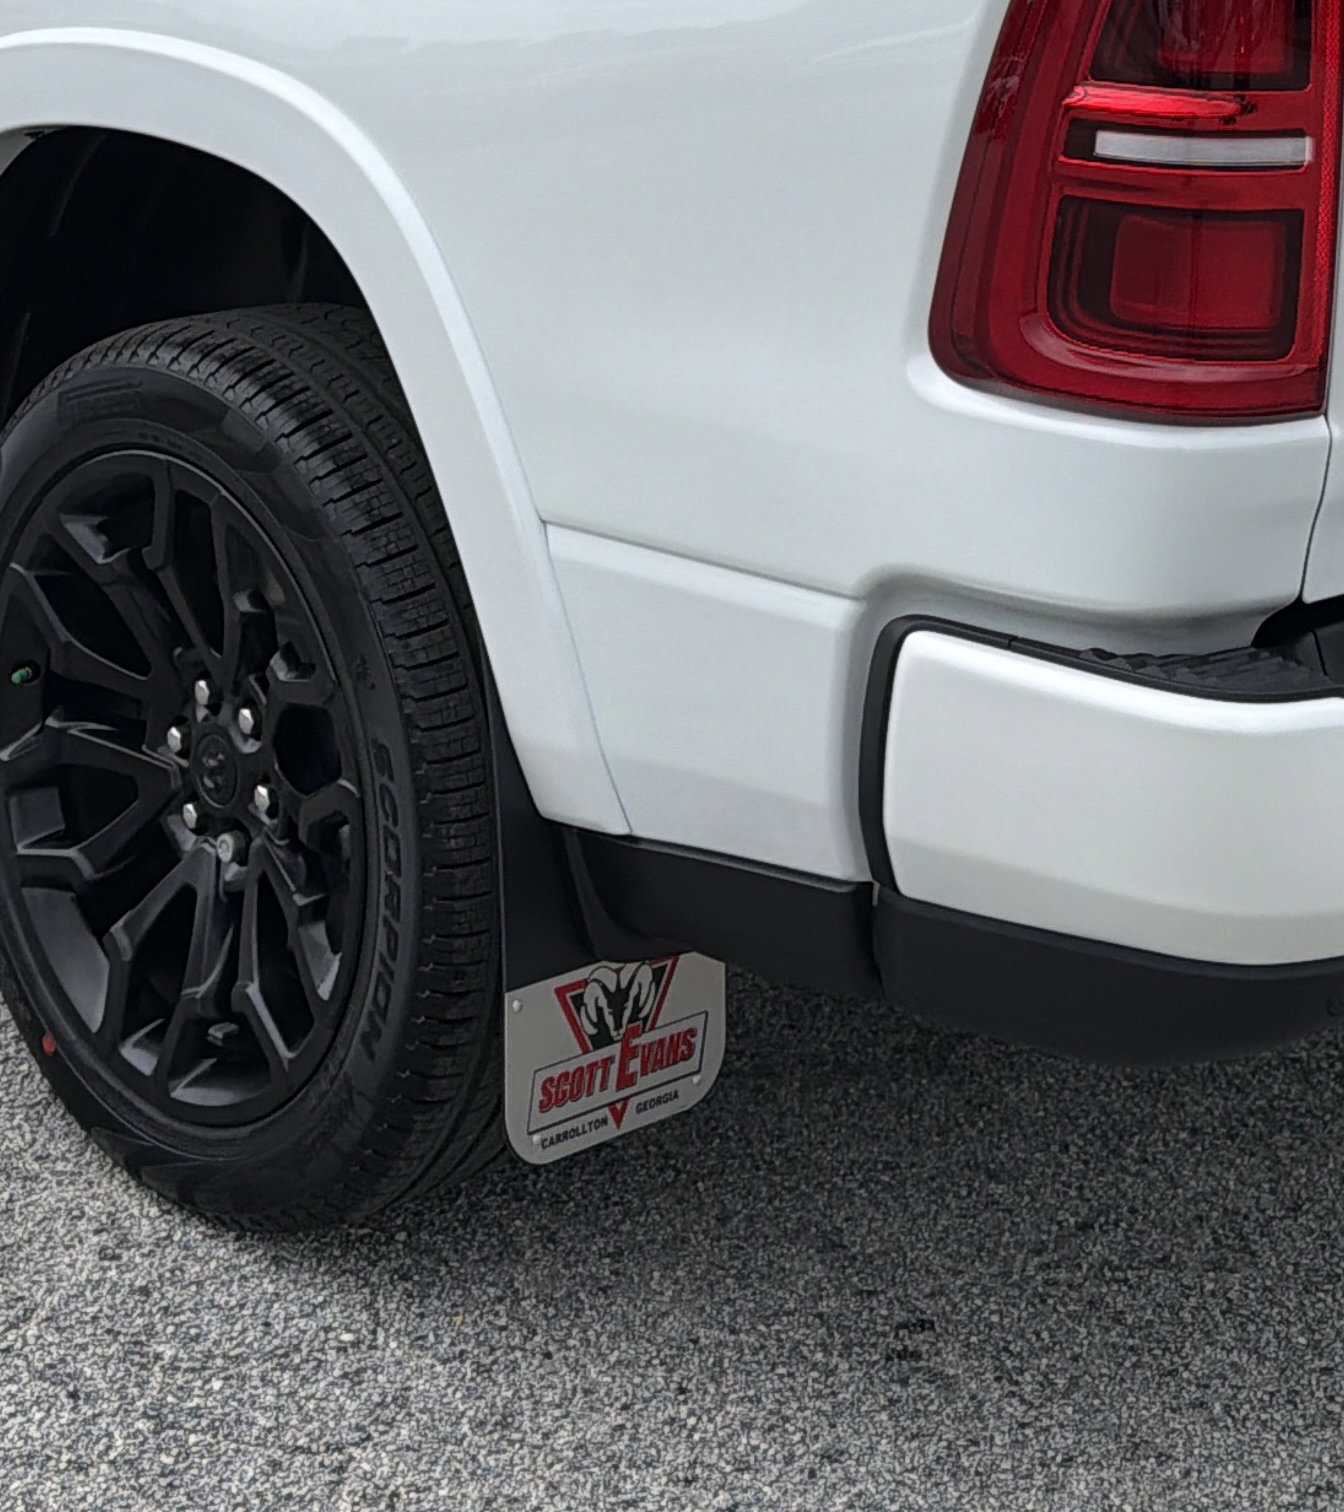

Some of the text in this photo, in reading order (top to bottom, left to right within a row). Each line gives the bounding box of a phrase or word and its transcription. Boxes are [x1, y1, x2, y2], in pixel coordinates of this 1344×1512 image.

[358, 738, 403, 1062] SCORPION
[538, 1023, 698, 1113] SCOTT EVANS
[540, 1090, 680, 1150] CARROLLTON GEORGIA
